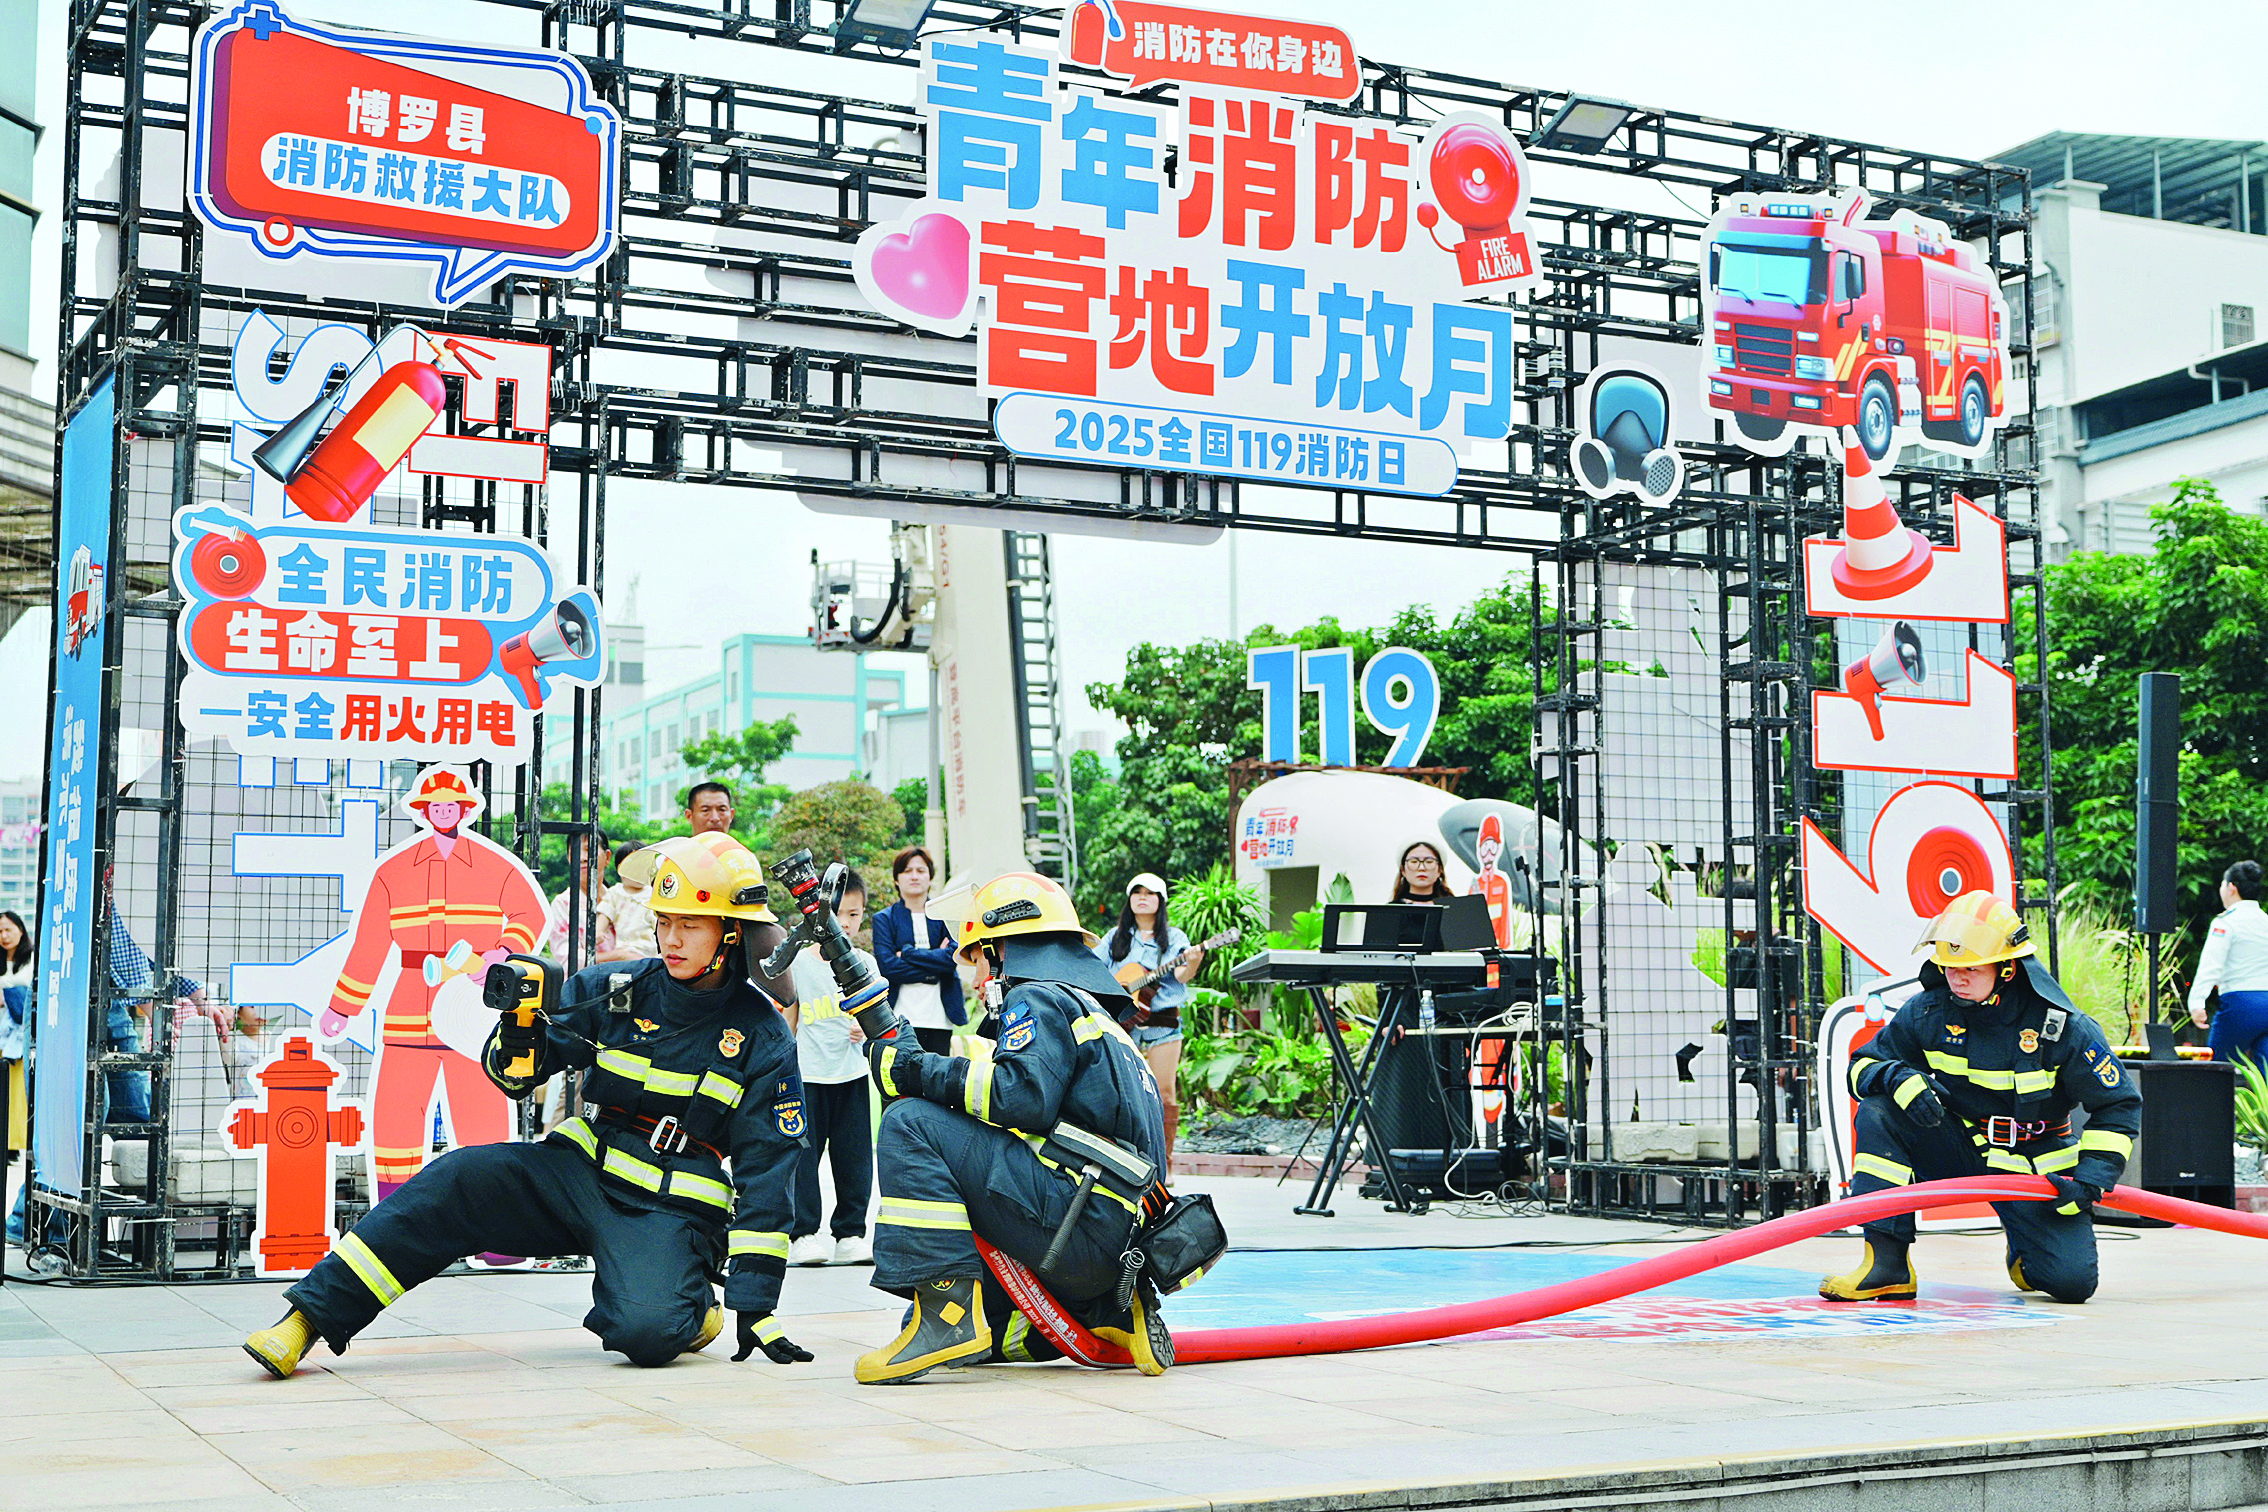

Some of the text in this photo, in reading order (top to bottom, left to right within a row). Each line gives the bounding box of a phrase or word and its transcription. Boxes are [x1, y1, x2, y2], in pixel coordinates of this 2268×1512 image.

[1132, 21, 1345, 79] 消防在你身边
[347, 86, 487, 154] 博罗县
[926, 40, 1410, 253] 青年消防
[272, 135, 562, 226] 消防救援大队
[1477, 252, 1525, 282] ALARM
[1480, 236, 1511, 259] FIRE
[978, 219, 1512, 442] 营地开放月
[1054, 408, 1407, 486] 2025全国119消防日
[277, 543, 513, 614] 全民消防
[225, 608, 461, 680] 生命至上
[1246, 645, 1441, 768] 119
[60, 718, 86, 979] 我很庞大
